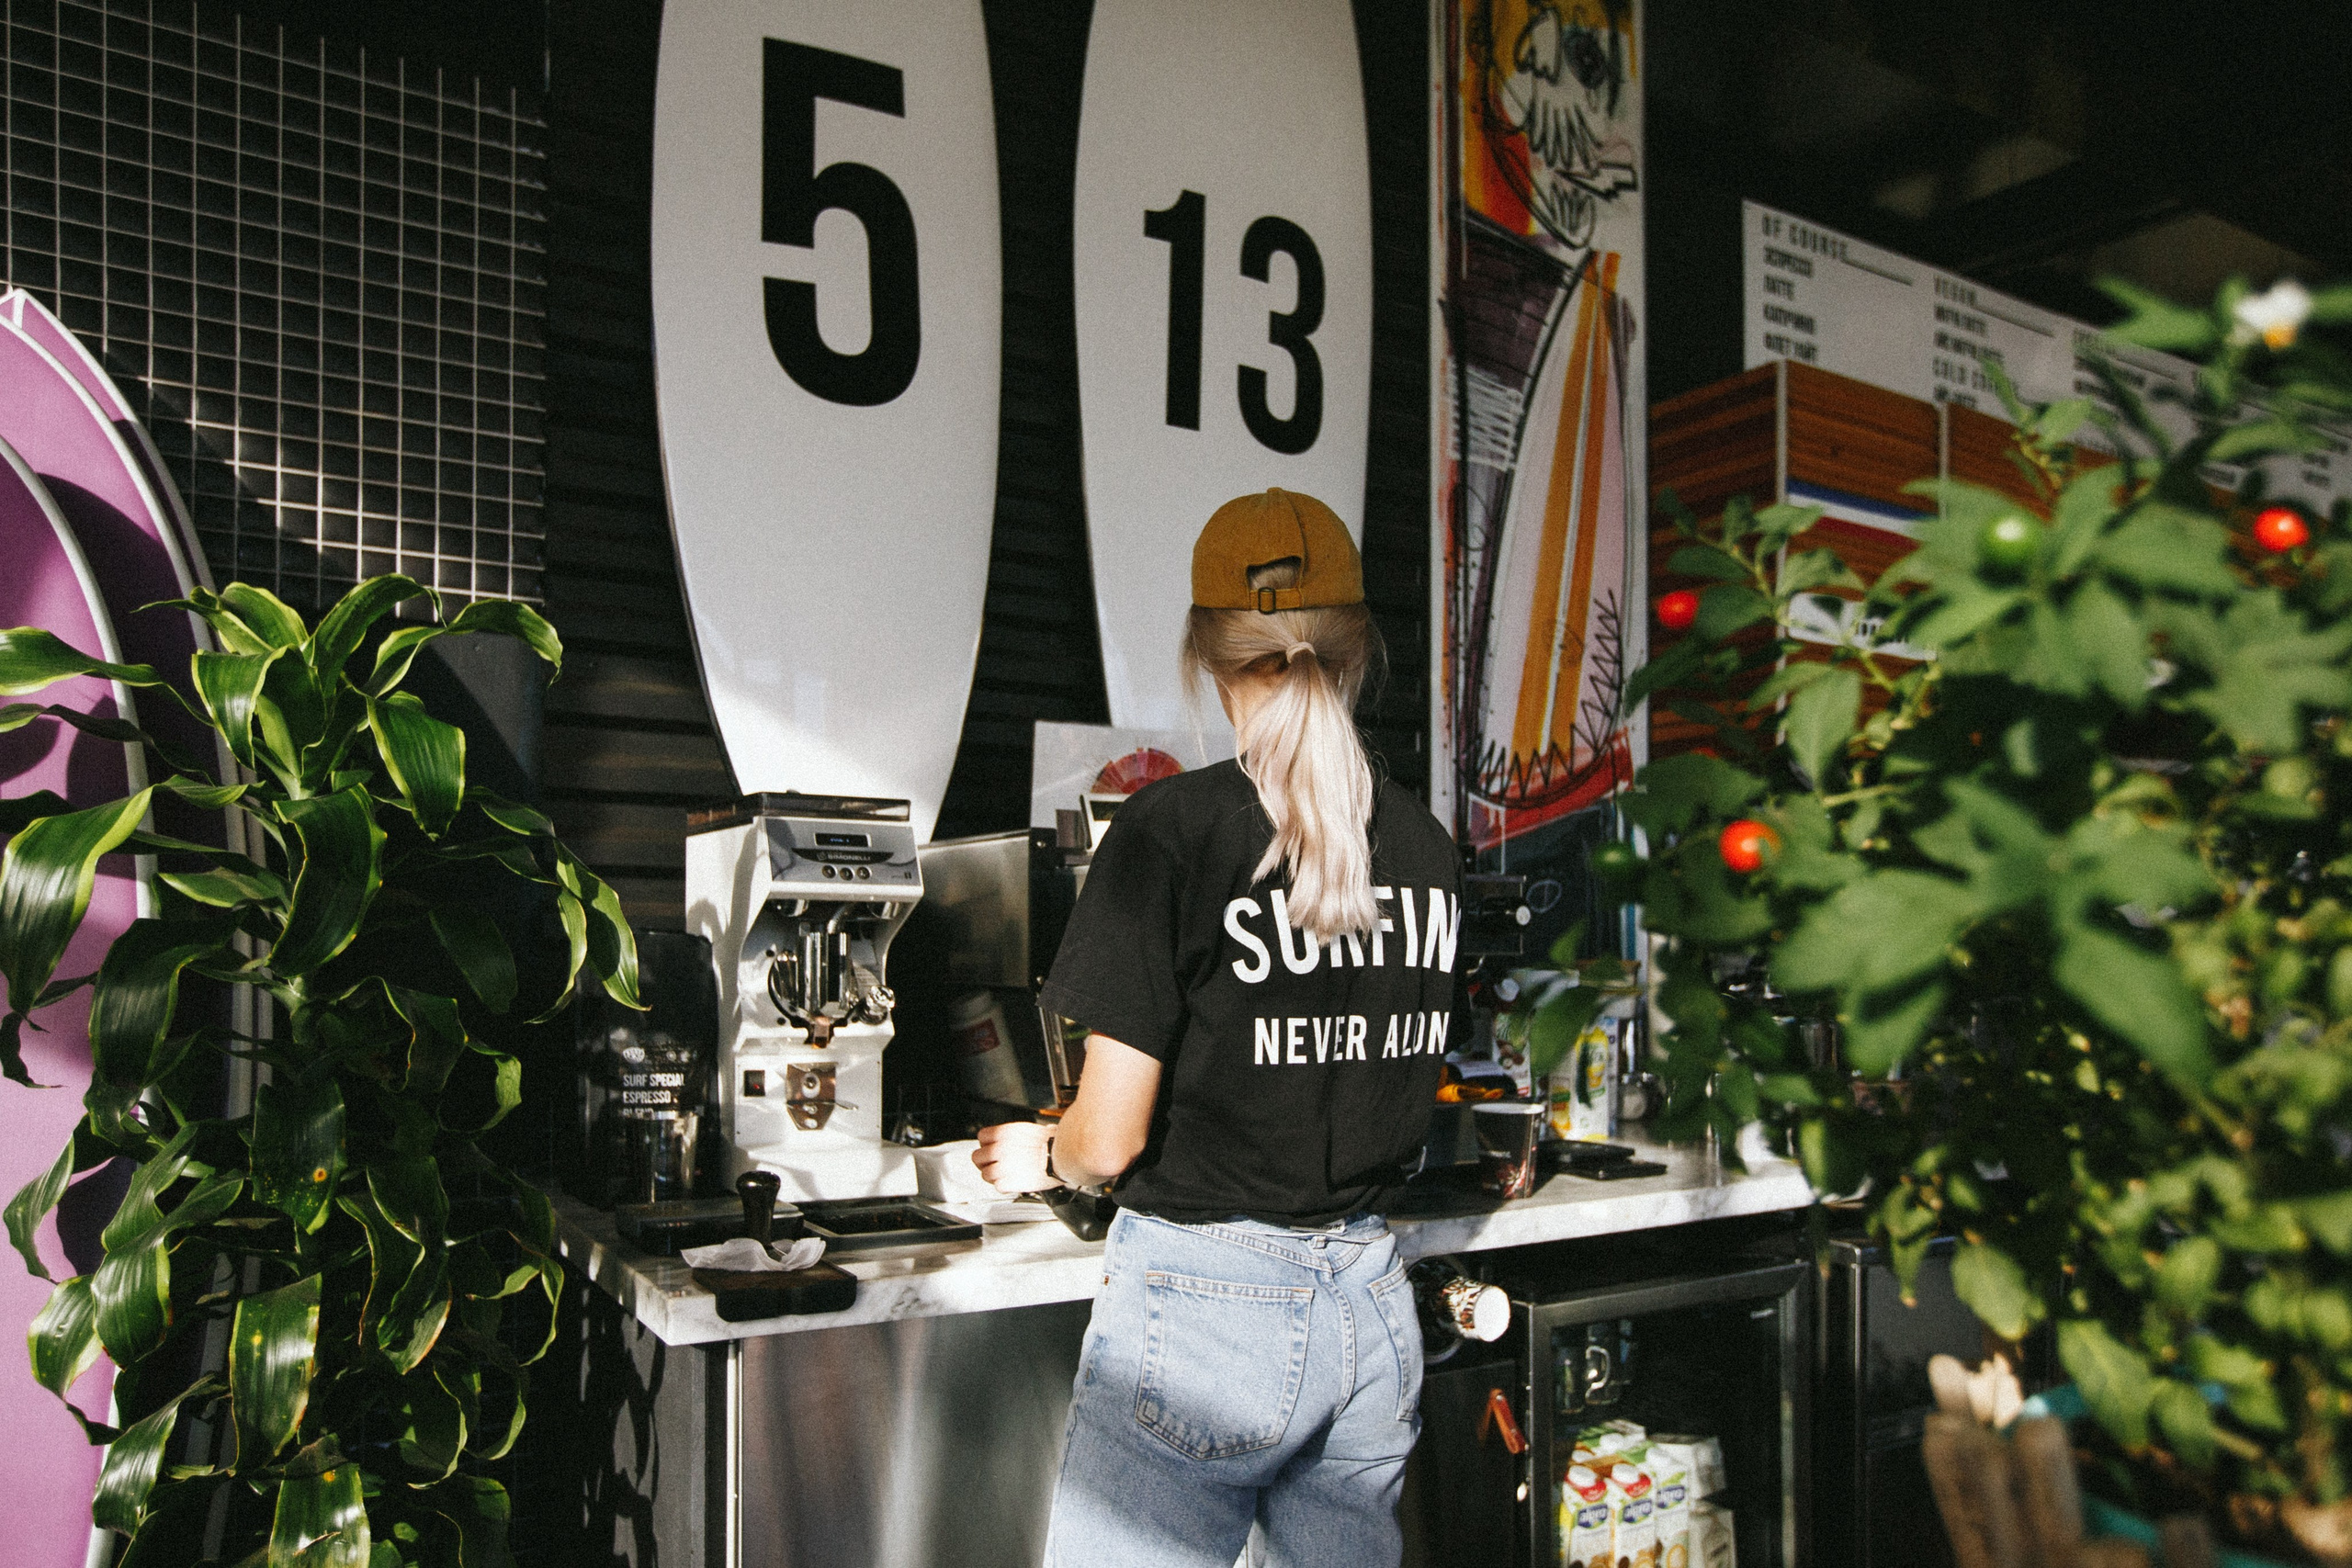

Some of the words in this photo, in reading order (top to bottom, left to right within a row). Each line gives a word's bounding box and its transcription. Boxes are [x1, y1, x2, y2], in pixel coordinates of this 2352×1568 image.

[762, 37, 921, 406] 5
[1762, 213, 1781, 239] OF
[1789, 222, 1848, 263] COURSE
[1144, 189, 1325, 455] 13
[1254, 1014, 1367, 1066] NEVER
[623, 1090, 672, 1104] ESPRESSO
[624, 1074, 648, 1087] SURF
[650, 1073, 685, 1087] SPECIAL
